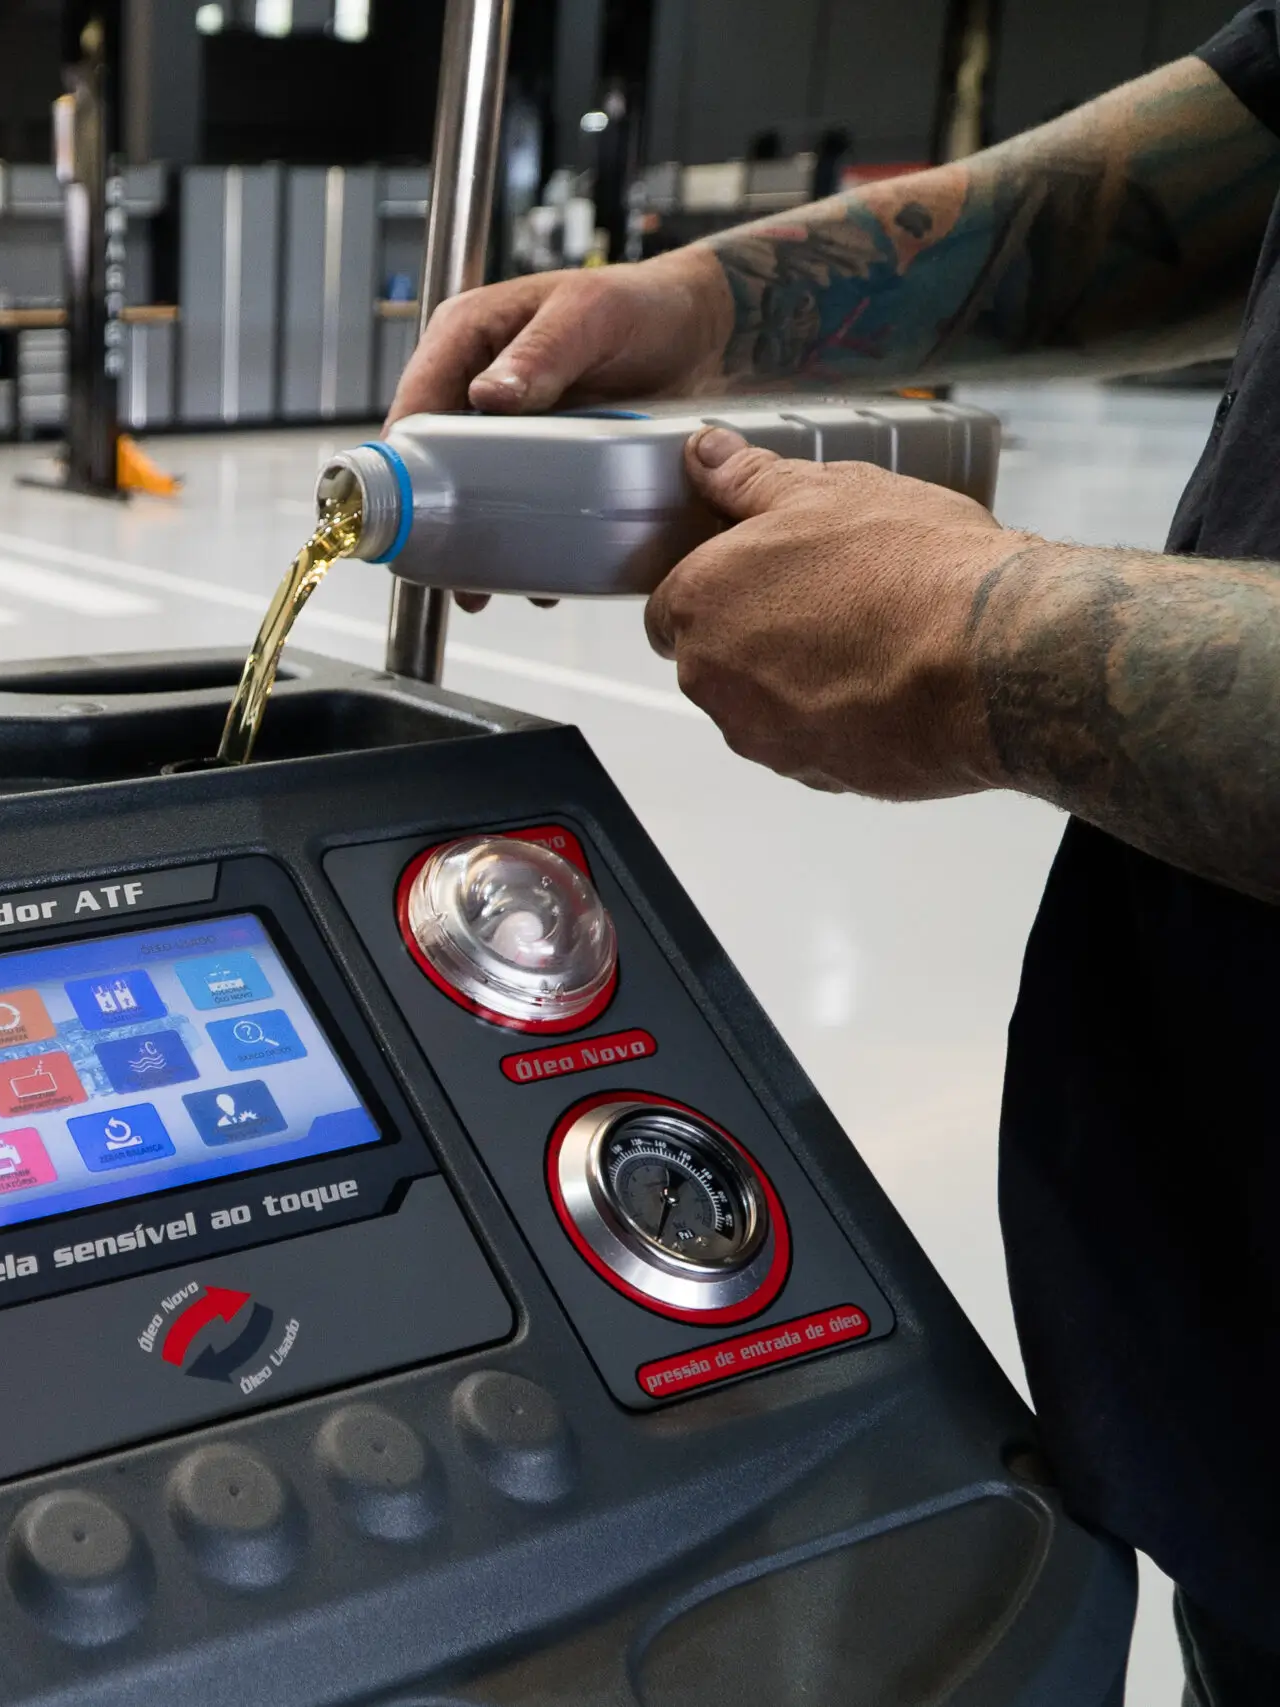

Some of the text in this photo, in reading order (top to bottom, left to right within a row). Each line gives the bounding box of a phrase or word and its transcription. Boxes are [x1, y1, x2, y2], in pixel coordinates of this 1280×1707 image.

[74, 882, 143, 914] ATF
[515, 1041, 646, 1080] Óleo Novo
[53, 1212, 197, 1269] sensível
[211, 1204, 251, 1231] ao
[262, 1178, 359, 1217] toque
[137, 1280, 199, 1353] Óleo Novo
[646, 1312, 863, 1392] pressão de entrada de óleo
[239, 1318, 300, 1395] Óleo Usado
